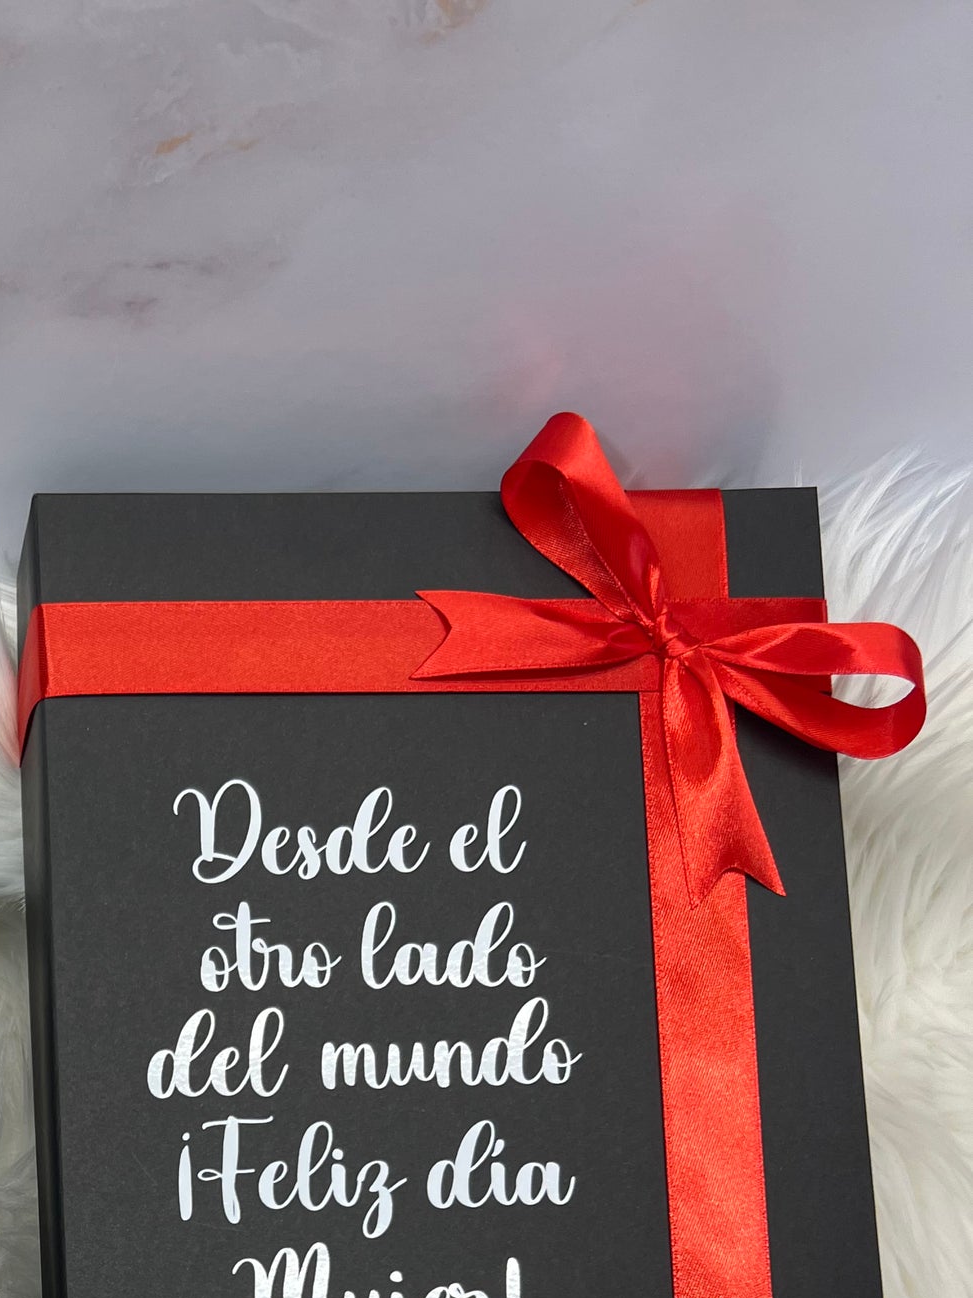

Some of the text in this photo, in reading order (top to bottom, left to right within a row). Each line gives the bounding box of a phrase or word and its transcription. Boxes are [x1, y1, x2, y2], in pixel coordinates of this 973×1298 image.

[173, 779, 526, 884] Desde el
[200, 901, 547, 992] otro lado
[146, 997, 583, 1099] del mundo
[178, 1116, 575, 1239] ¡Feliz día
